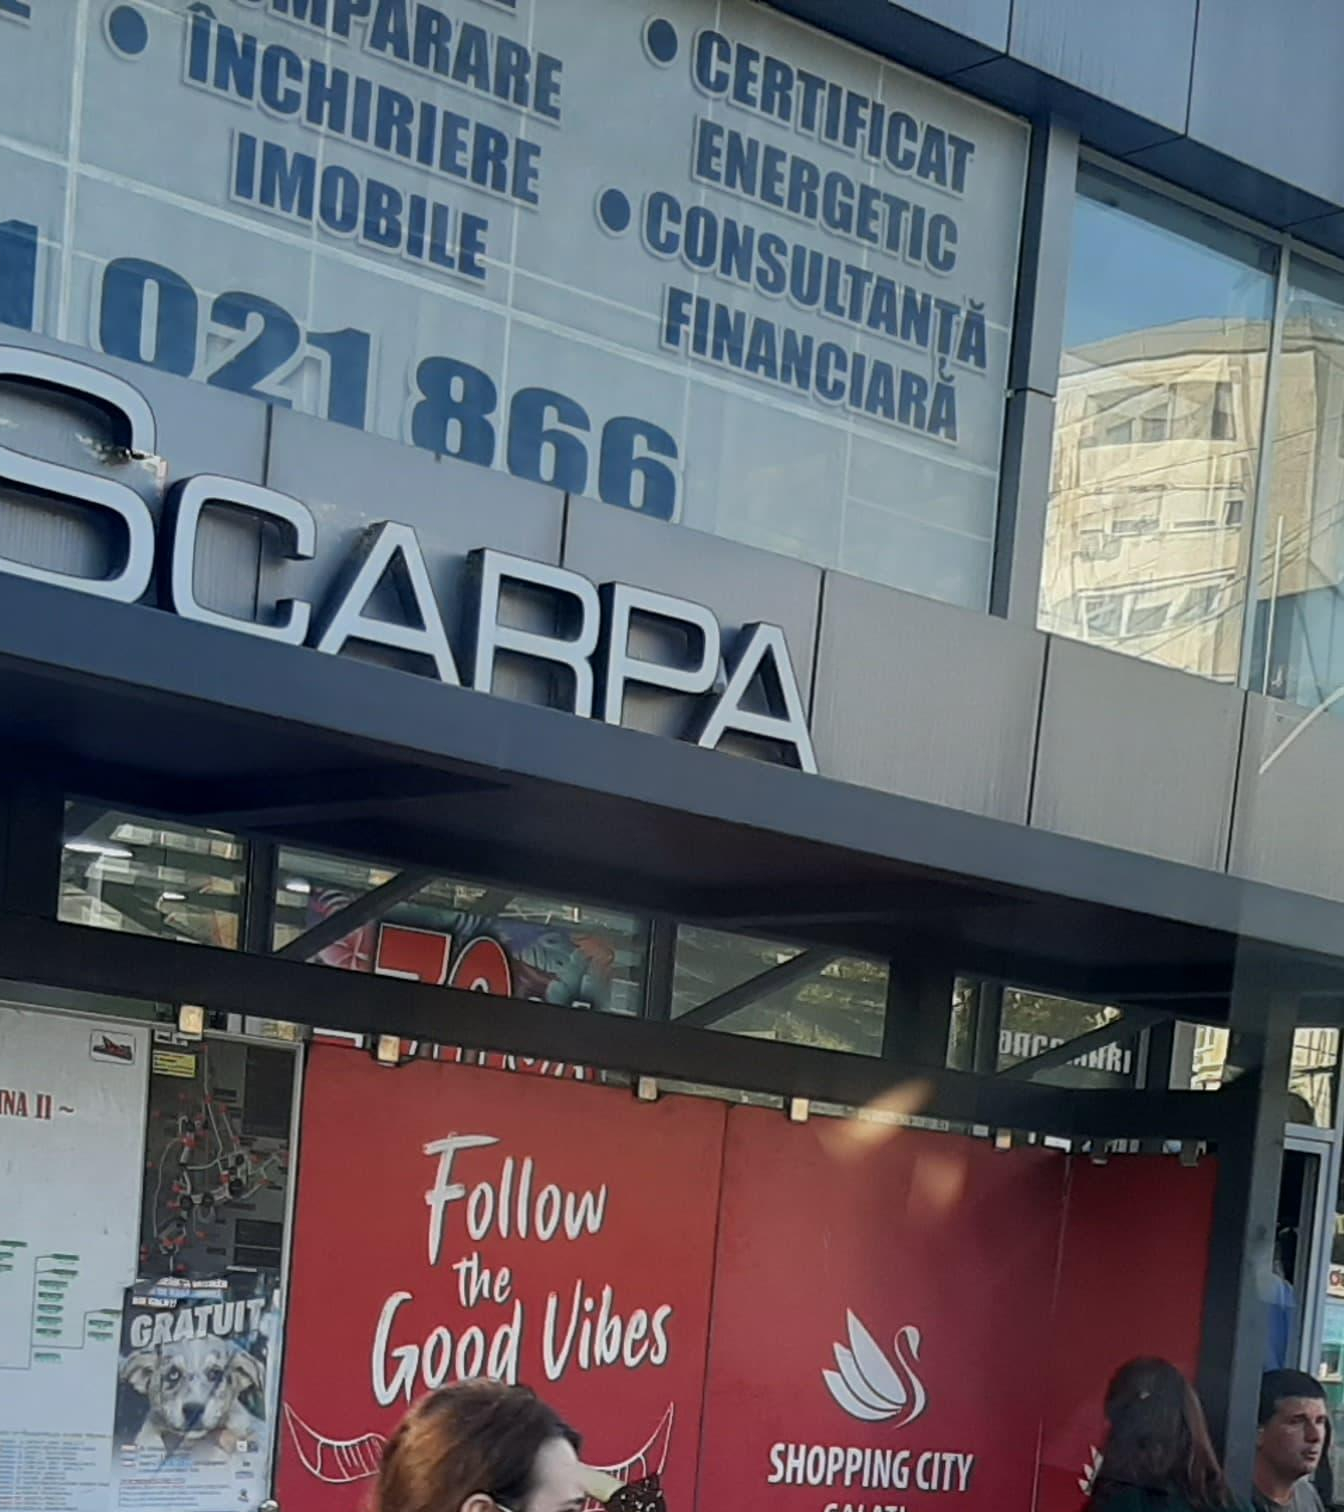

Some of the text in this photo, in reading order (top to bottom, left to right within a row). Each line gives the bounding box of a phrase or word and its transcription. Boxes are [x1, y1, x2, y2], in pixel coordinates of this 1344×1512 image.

[187, 4, 541, 204] ÎNCHIRIERE
[695, 29, 975, 193] CERTIFICAT
[233, 131, 488, 280] IMOBILE
[696, 119, 958, 273] ENERGETIC
[98, 257, 373, 430] 021
[411, 356, 679, 523] 866
[662, 286, 958, 443] FINANCIARĂ
[422, 1131, 607, 1266] Follow
[130, 1298, 266, 1349] GRATUIT
[371, 1279, 673, 1408] Good Vibes
[452, 1251, 513, 1308] the
[767, 1442, 975, 1492] SHOPPING CITY
